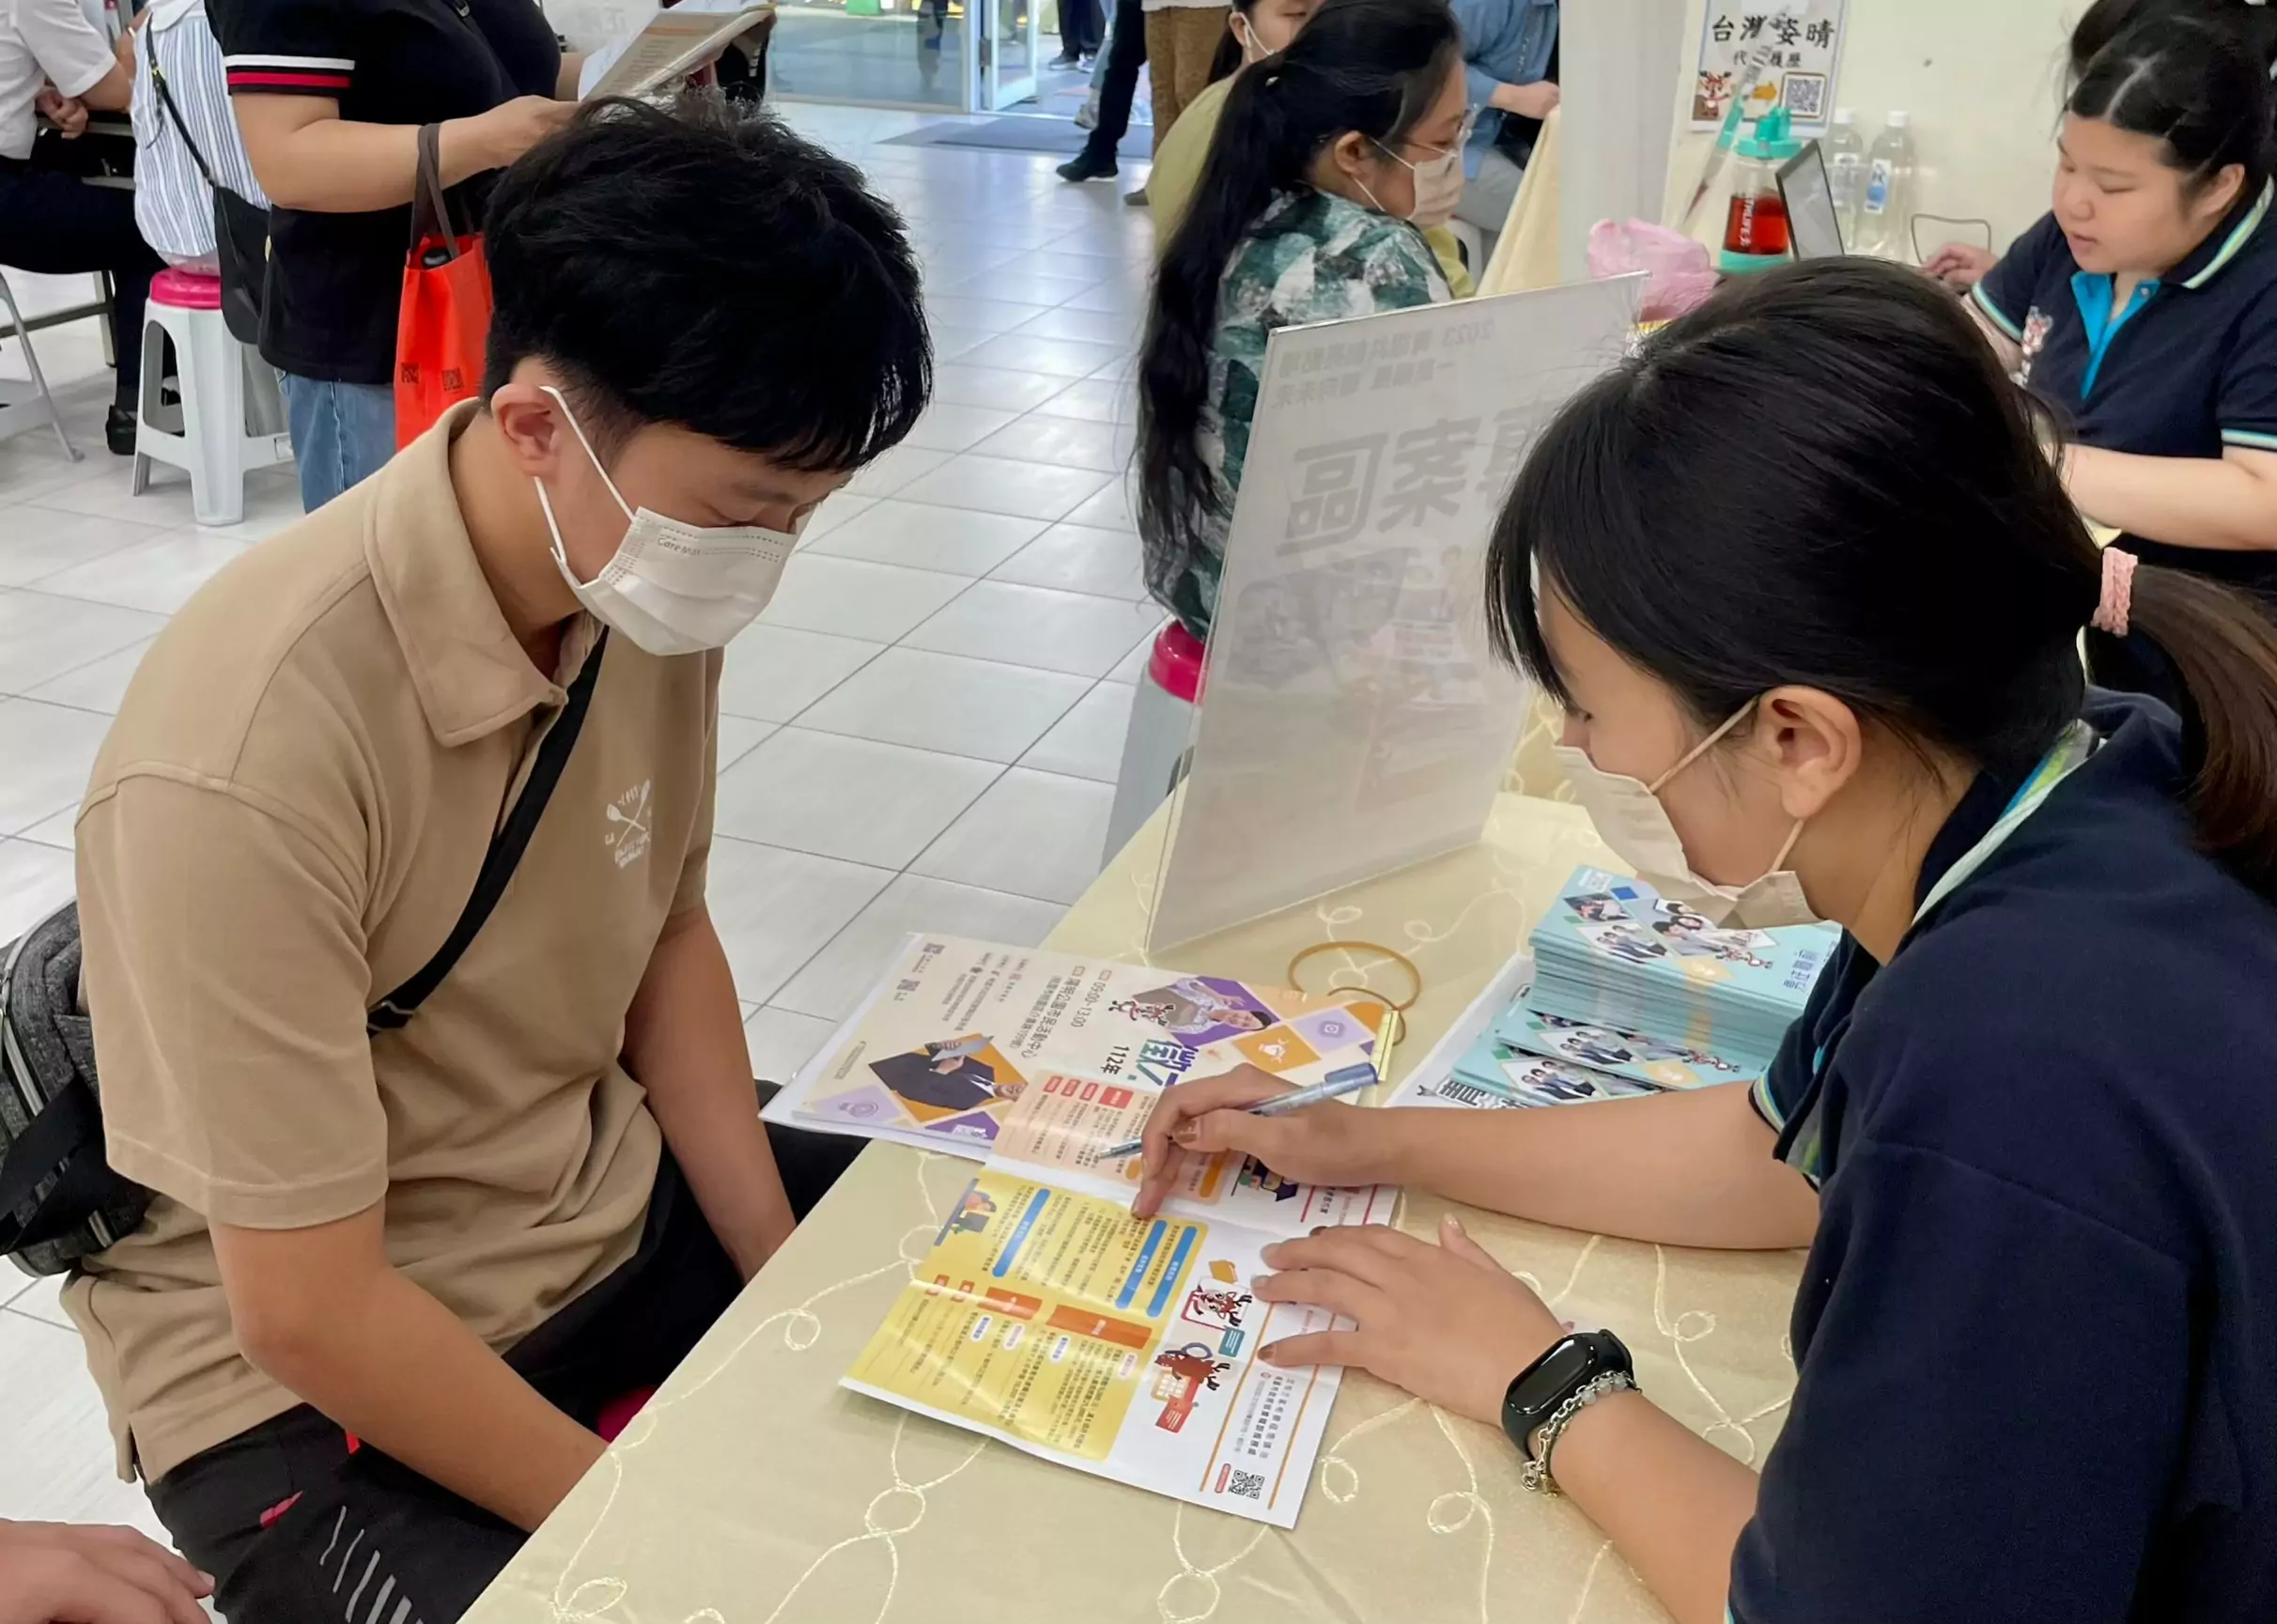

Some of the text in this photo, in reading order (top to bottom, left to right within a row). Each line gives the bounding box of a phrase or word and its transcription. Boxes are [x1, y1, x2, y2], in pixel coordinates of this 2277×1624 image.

[1733, 49, 1802, 68] 代履歷
[1100, 1044, 1131, 1075] 112年
